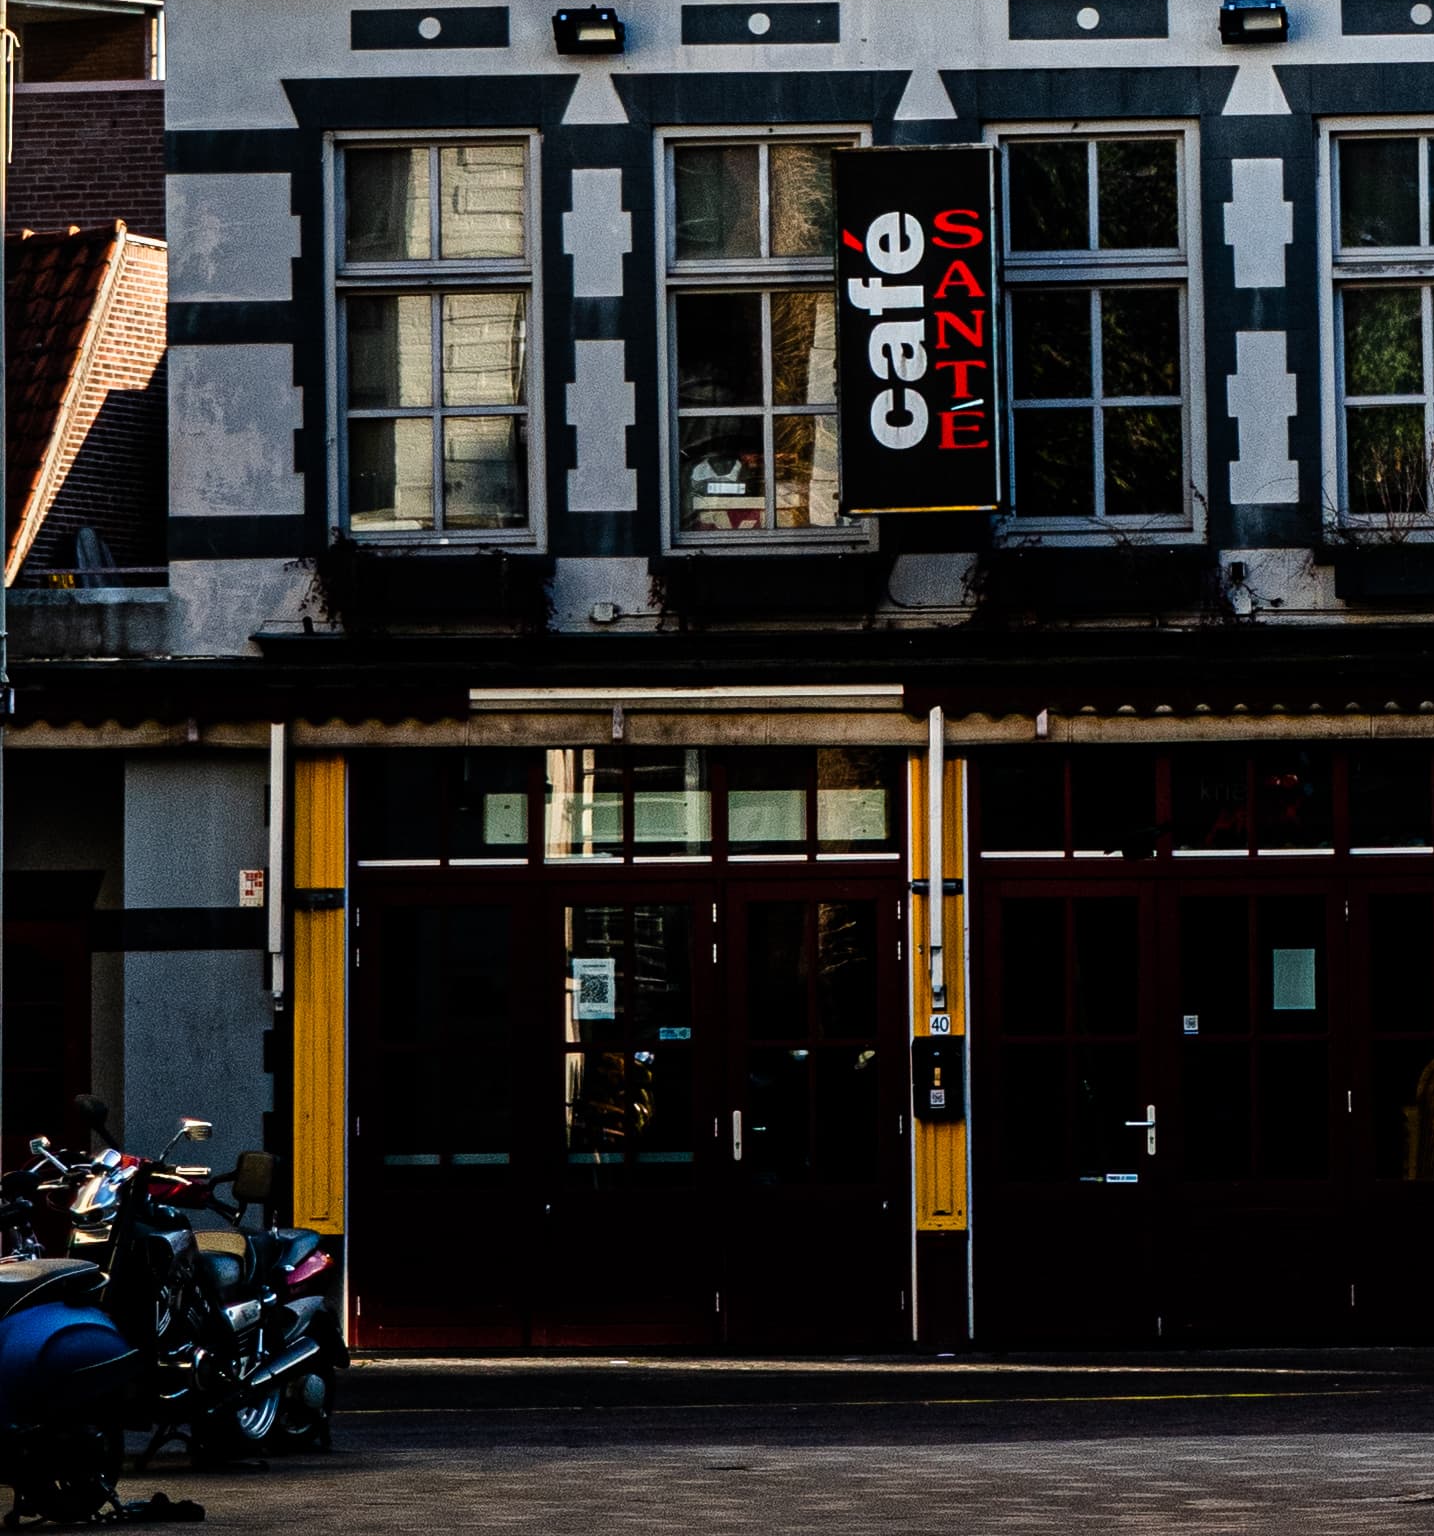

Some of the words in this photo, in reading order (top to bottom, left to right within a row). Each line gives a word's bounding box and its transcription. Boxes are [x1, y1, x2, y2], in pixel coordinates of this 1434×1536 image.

[842, 210, 930, 451] café
[930, 208, 990, 451] SANTÉ
[931, 1016, 949, 1033] 40
